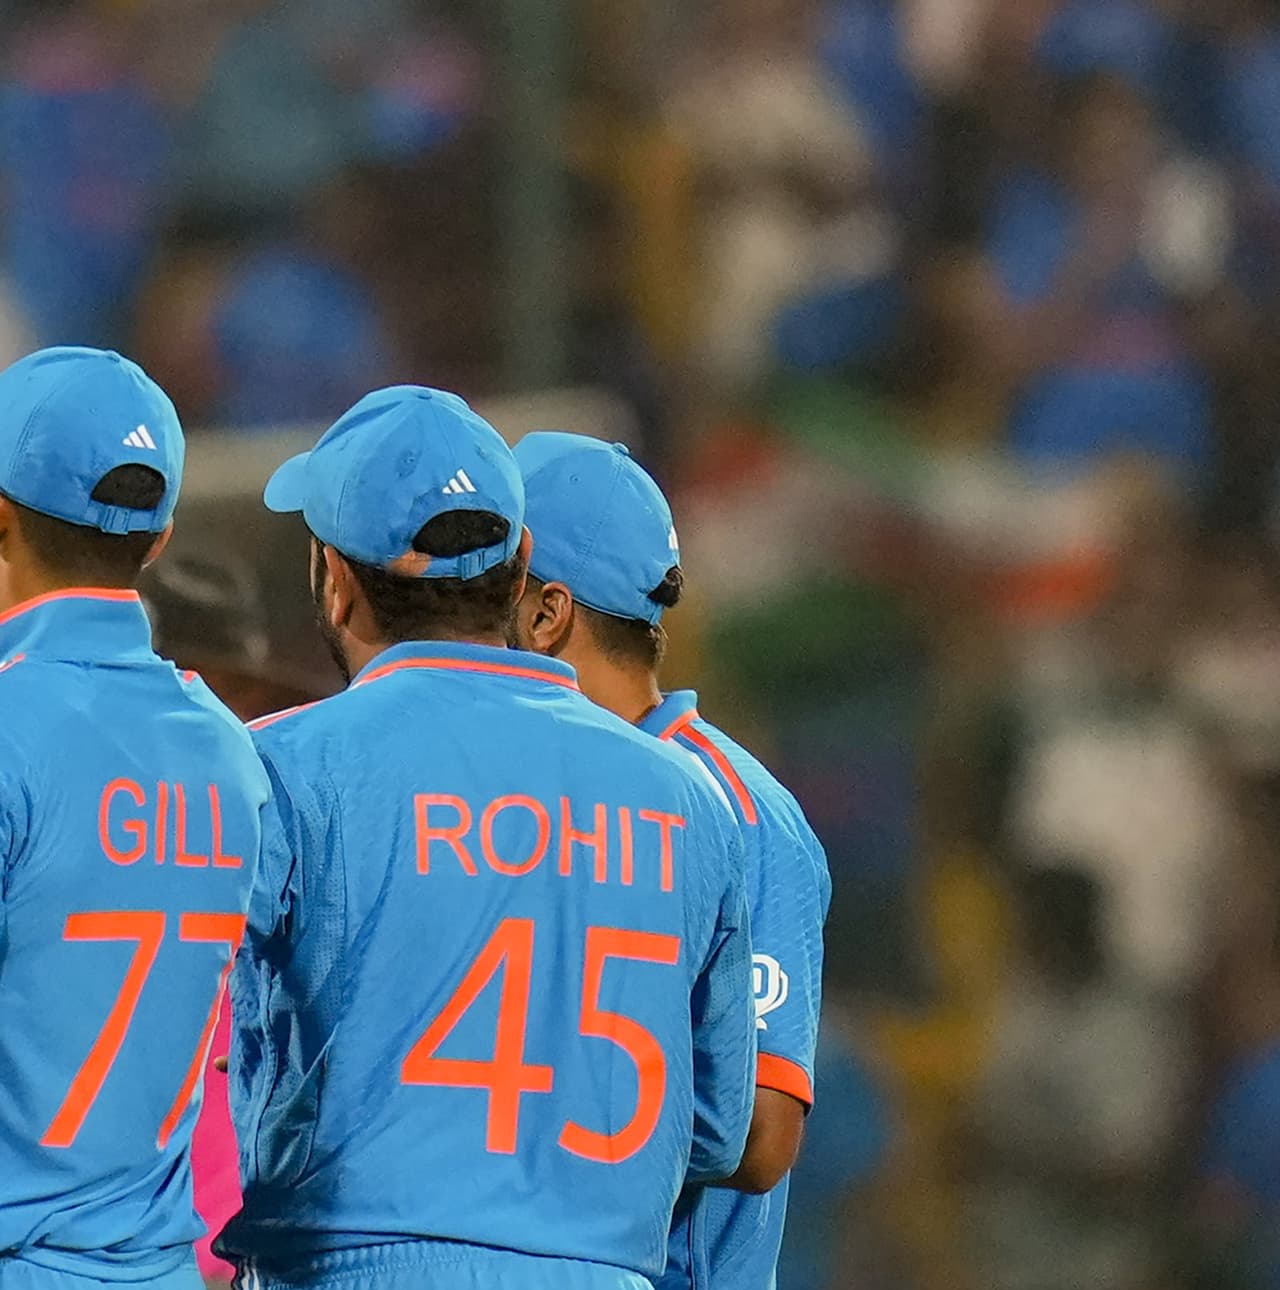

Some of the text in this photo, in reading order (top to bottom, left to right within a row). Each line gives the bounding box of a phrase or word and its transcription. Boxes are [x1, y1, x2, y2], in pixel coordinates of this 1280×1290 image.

[98, 777, 243, 868] GILL
[413, 793, 686, 892] ROHIT
[39, 911, 247, 1150] 77
[400, 918, 680, 1163] 45
